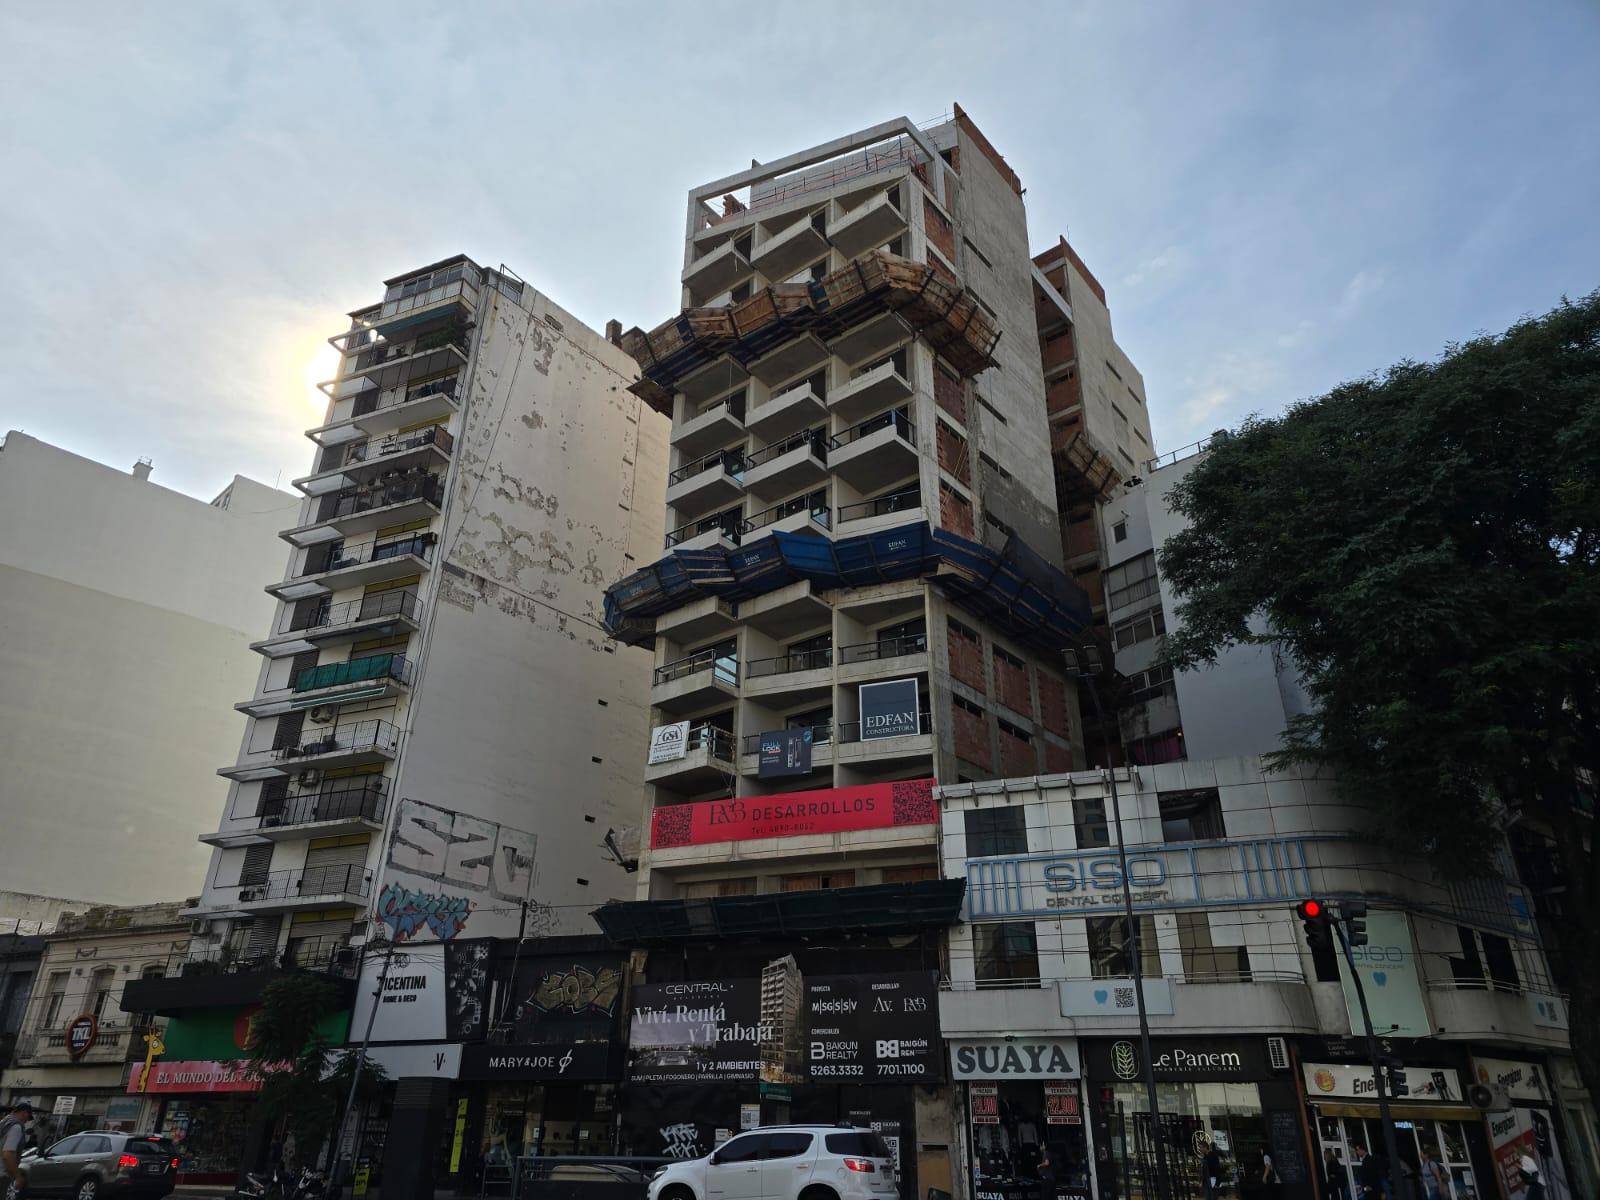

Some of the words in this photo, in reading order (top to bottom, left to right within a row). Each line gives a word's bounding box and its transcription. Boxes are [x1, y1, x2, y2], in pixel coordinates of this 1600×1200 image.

[866, 711, 914, 728] EDFAN
[866, 724, 914, 736] CONSTRUCTORA
[752, 798, 876, 821] DESARROLLOS
[1044, 857, 1166, 892] SISO
[1046, 895, 1099, 907] DENTAL
[665, 983, 728, 995] CENTRAL
[634, 1004, 671, 1025] Viví.
[676, 1002, 727, 1023] Rentá
[72, 1026, 91, 1041] TKL
[688, 1028, 699, 1043] y
[701, 1020, 774, 1047] Trabajá
[826, 1050, 858, 1060] REALTY
[957, 1044, 1074, 1073] SUAYA
[1174, 1049, 1241, 1067] Panem
[489, 1056, 555, 1068] MARY&JOE
[696, 1062, 701, 1071] 1
[701, 1063, 707, 1072] y
[709, 1061, 715, 1071] 2
[716, 1061, 766, 1070] AMBIENTES
[810, 1065, 864, 1076] 5263.3332
[876, 1063, 925, 1075] 7701.1100
[156, 1071, 170, 1084] EL
[173, 1071, 213, 1084] MUNDO
[214, 1071, 237, 1083] DEL
